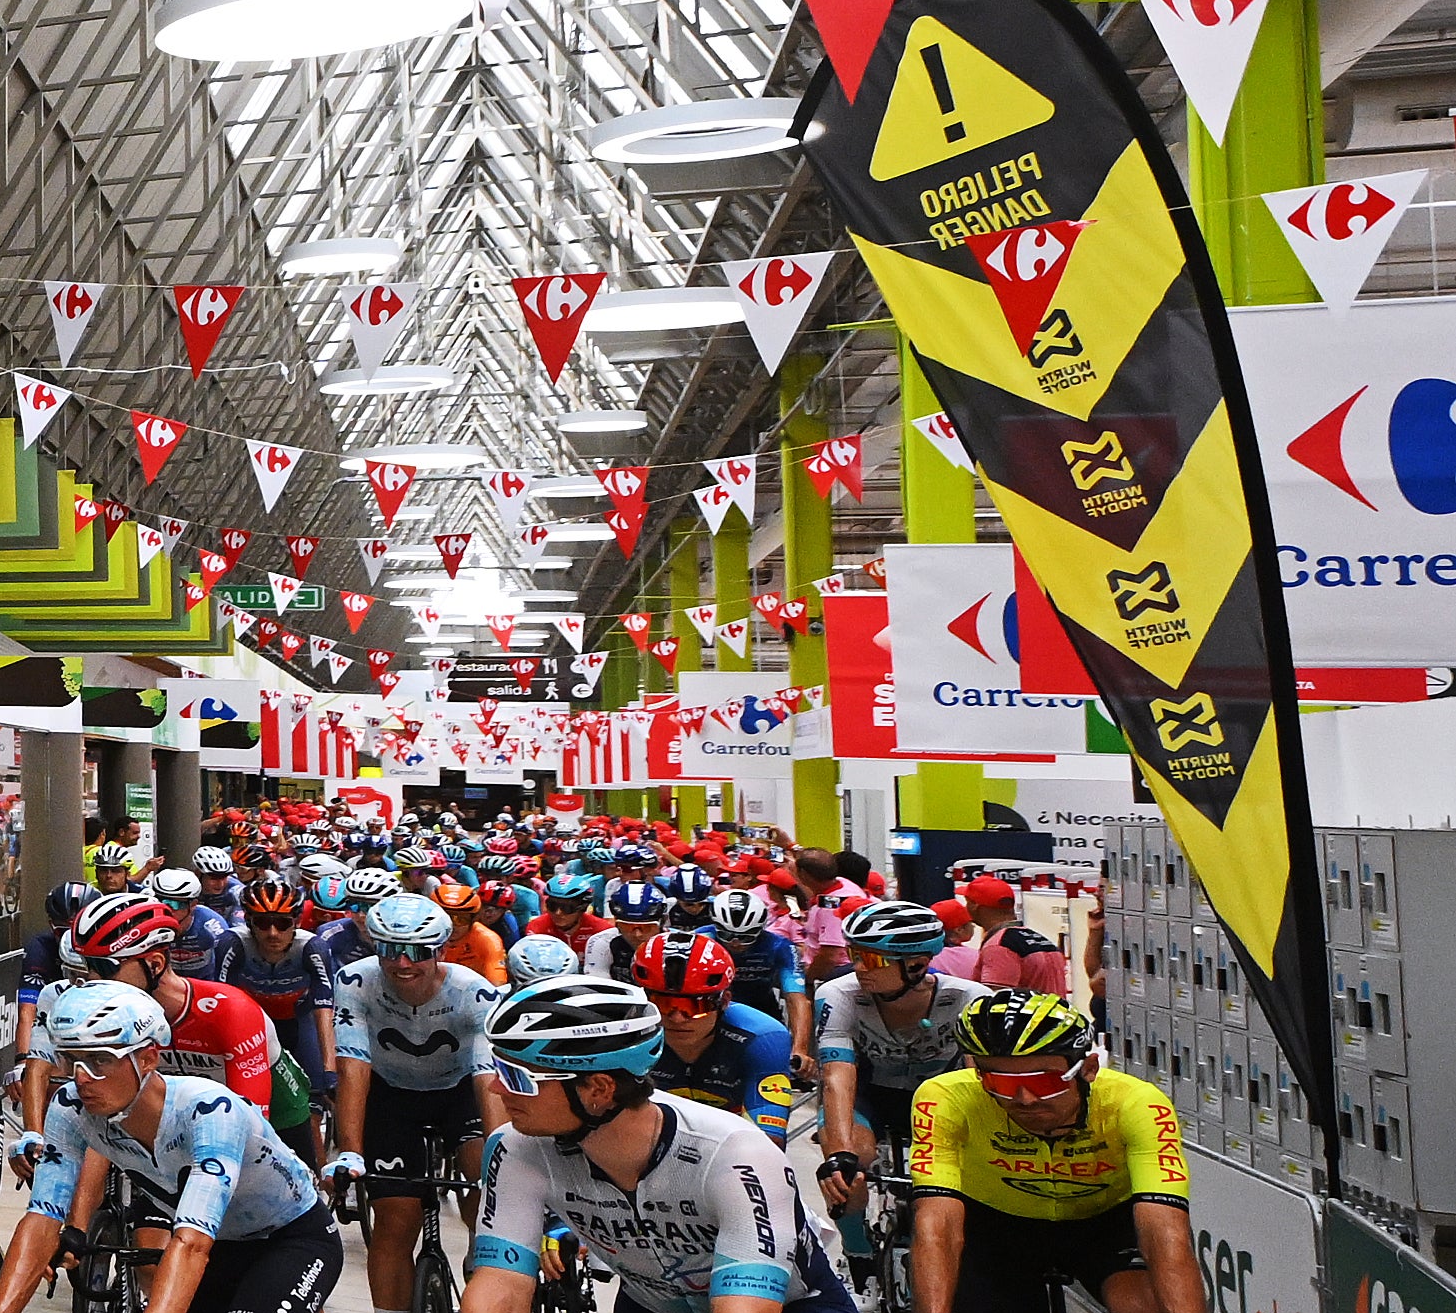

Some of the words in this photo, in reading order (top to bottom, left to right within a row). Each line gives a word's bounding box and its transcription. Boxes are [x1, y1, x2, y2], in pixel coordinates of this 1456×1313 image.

[701, 739, 791, 757] Carrefou
[109, 928, 141, 953] GIRO
[233, 1030, 266, 1056] VISMA
[235, 1052, 264, 1070] lease
[534, 1055, 597, 1066] RUDY
[911, 1100, 936, 1176] ARKEA
[1148, 1103, 1187, 1184] ARKEA
[989, 1155, 1116, 1179] ARKEA
[480, 1140, 507, 1230] MERIDA
[566, 1210, 720, 1243] BAHRAIN
[733, 1165, 777, 1260] MERIDA
[290, 1258, 325, 1302] Telefónica
